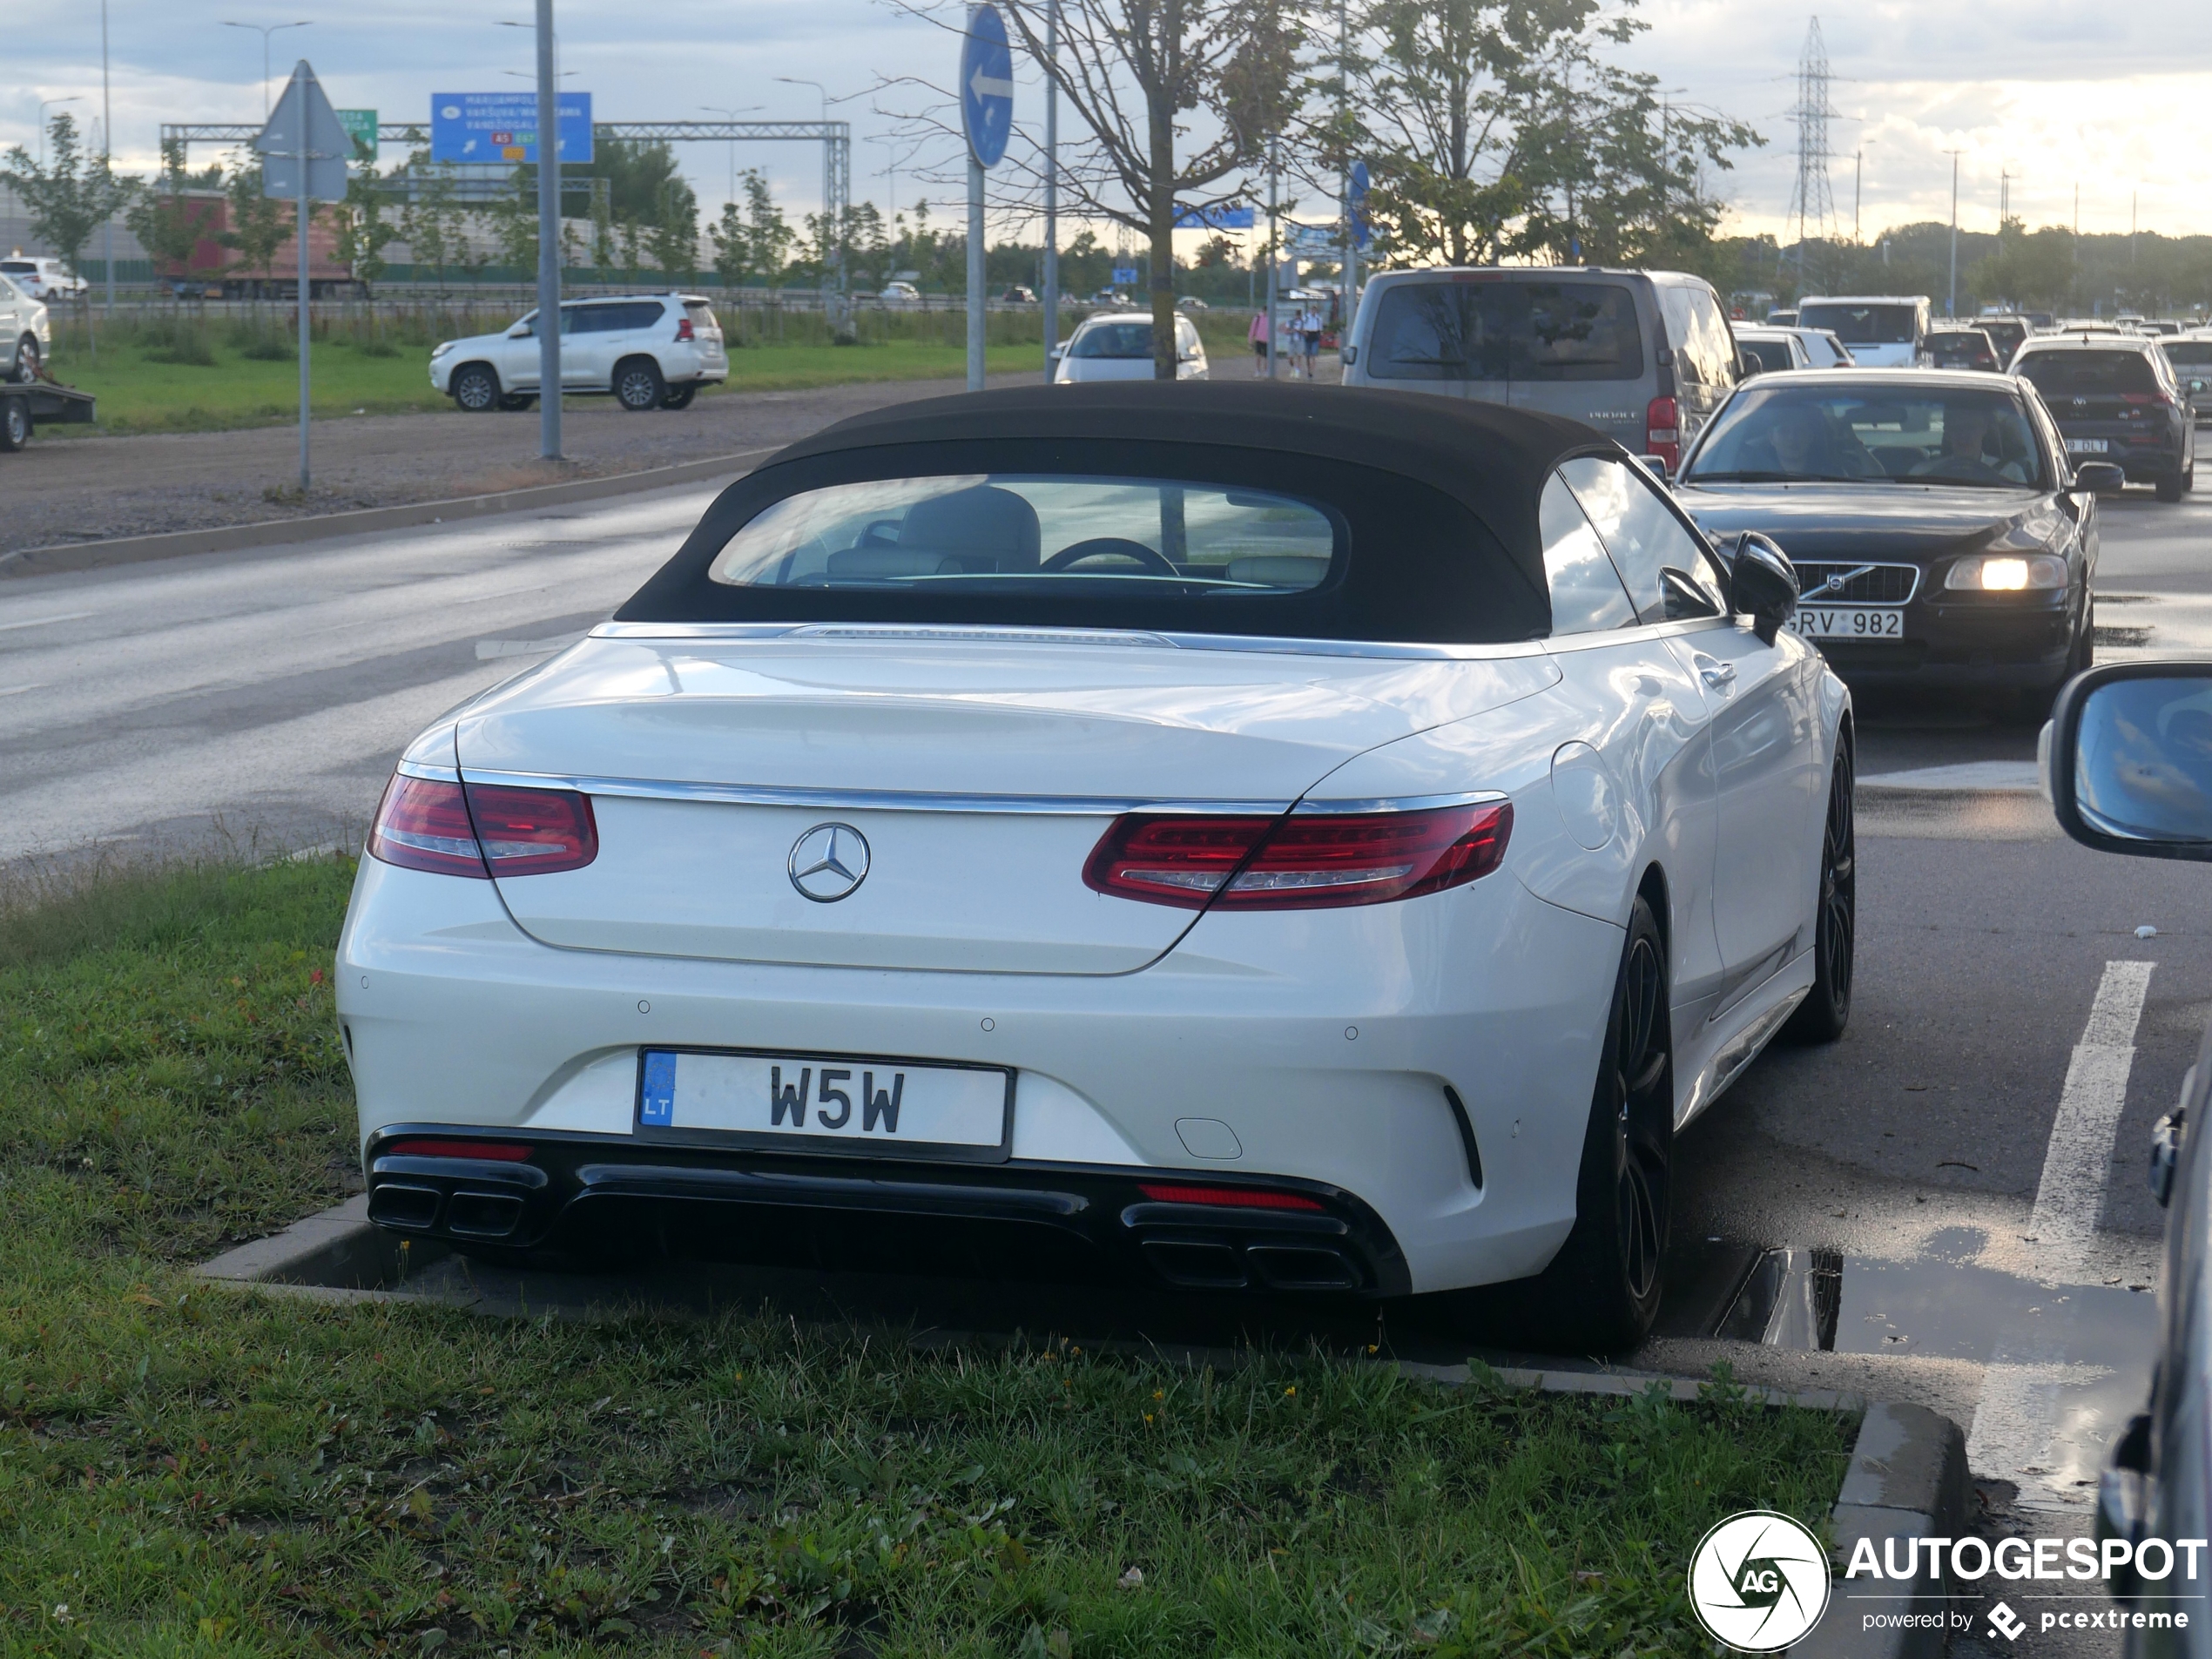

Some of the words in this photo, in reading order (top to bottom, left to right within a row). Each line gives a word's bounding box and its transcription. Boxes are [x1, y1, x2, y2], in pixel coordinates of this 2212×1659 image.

[1853, 613, 1898, 635] 982
[644, 1098, 670, 1116] LT
[771, 1066, 904, 1132] W5W
